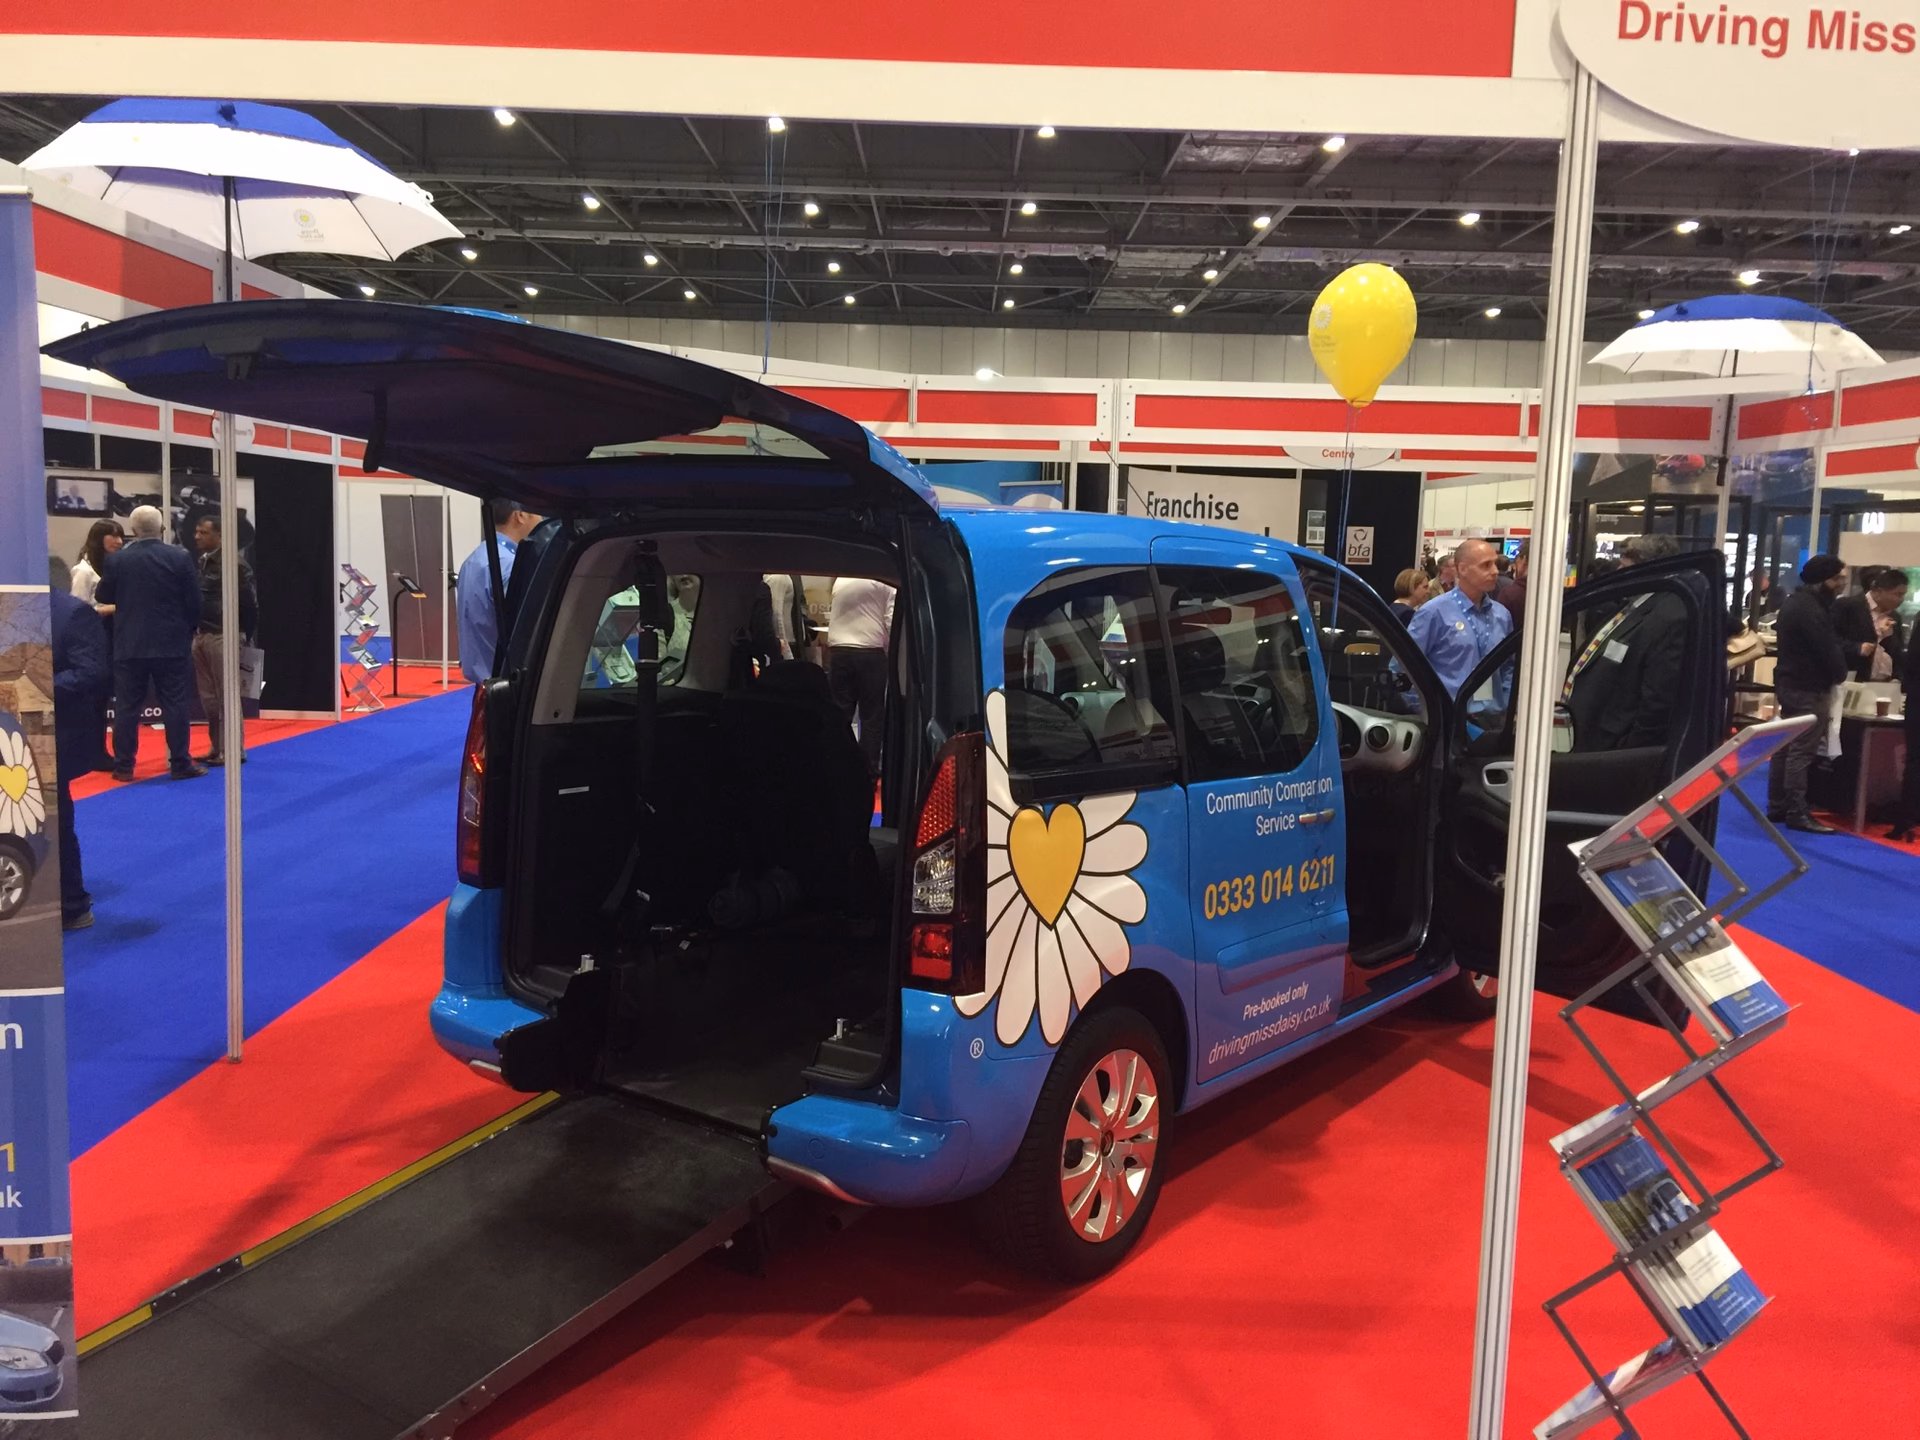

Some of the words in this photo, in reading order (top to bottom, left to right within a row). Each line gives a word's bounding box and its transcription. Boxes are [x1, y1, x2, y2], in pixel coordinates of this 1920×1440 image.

[1618, 0, 1789, 59] Driving
[1807, 9, 1916, 54] Miss
[1322, 449, 1355, 459] Centre
[1147, 491, 1239, 521] Franchise
[1348, 544, 1371, 557] bfa
[1206, 785, 1273, 814] Community
[1256, 812, 1296, 836] Service
[1204, 874, 1255, 920] 0333
[1261, 864, 1294, 904] 014
[1299, 853, 1335, 893] 6211
[1242, 987, 1291, 1021] Pre-booked
[1291, 980, 1309, 1000] only
[1208, 994, 1332, 1065] drivingmissdaisy.co.uk
